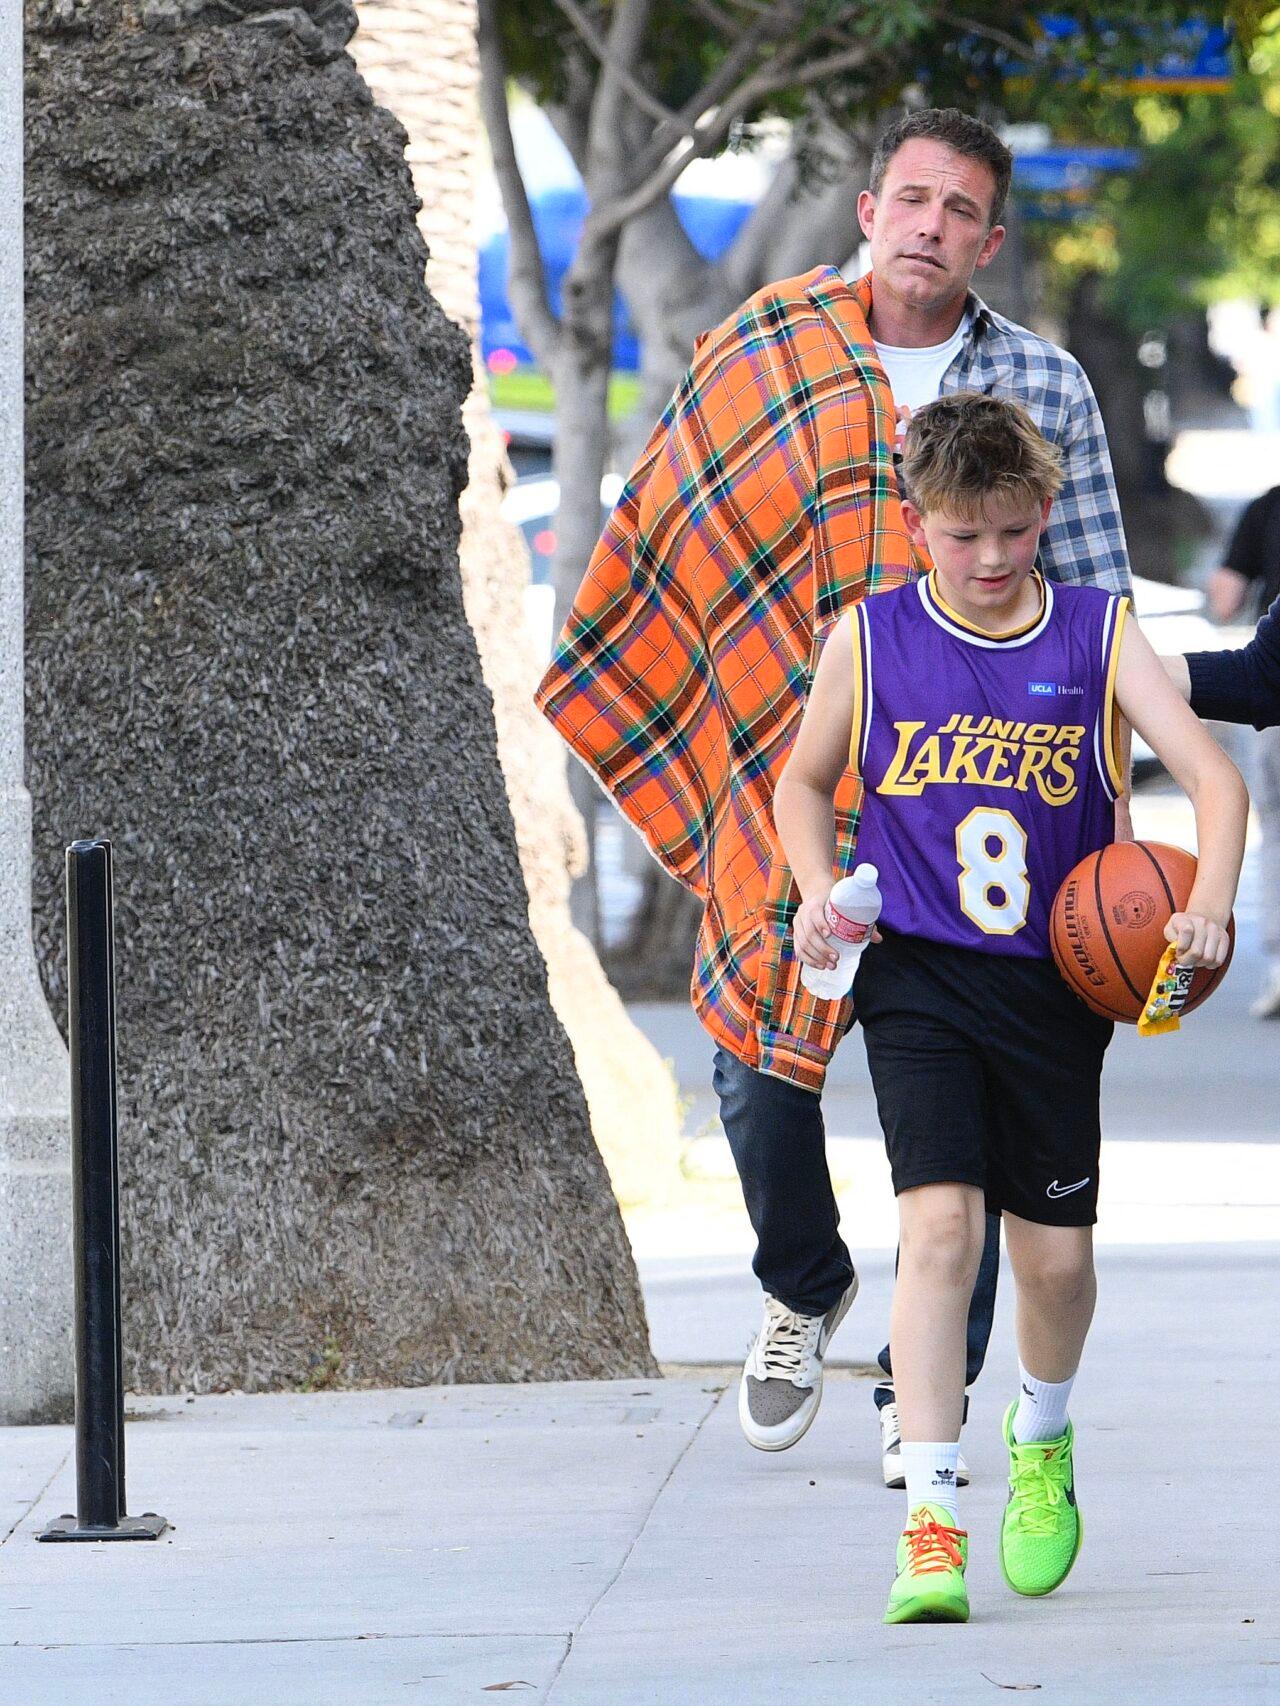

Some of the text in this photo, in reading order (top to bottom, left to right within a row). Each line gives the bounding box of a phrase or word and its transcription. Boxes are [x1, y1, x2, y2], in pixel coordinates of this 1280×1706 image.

[1031, 684, 1084, 695] UCLA Health
[937, 713, 1087, 746] JUNIOR
[875, 721, 1081, 808] LAKERS
[955, 805, 1031, 936] 8
